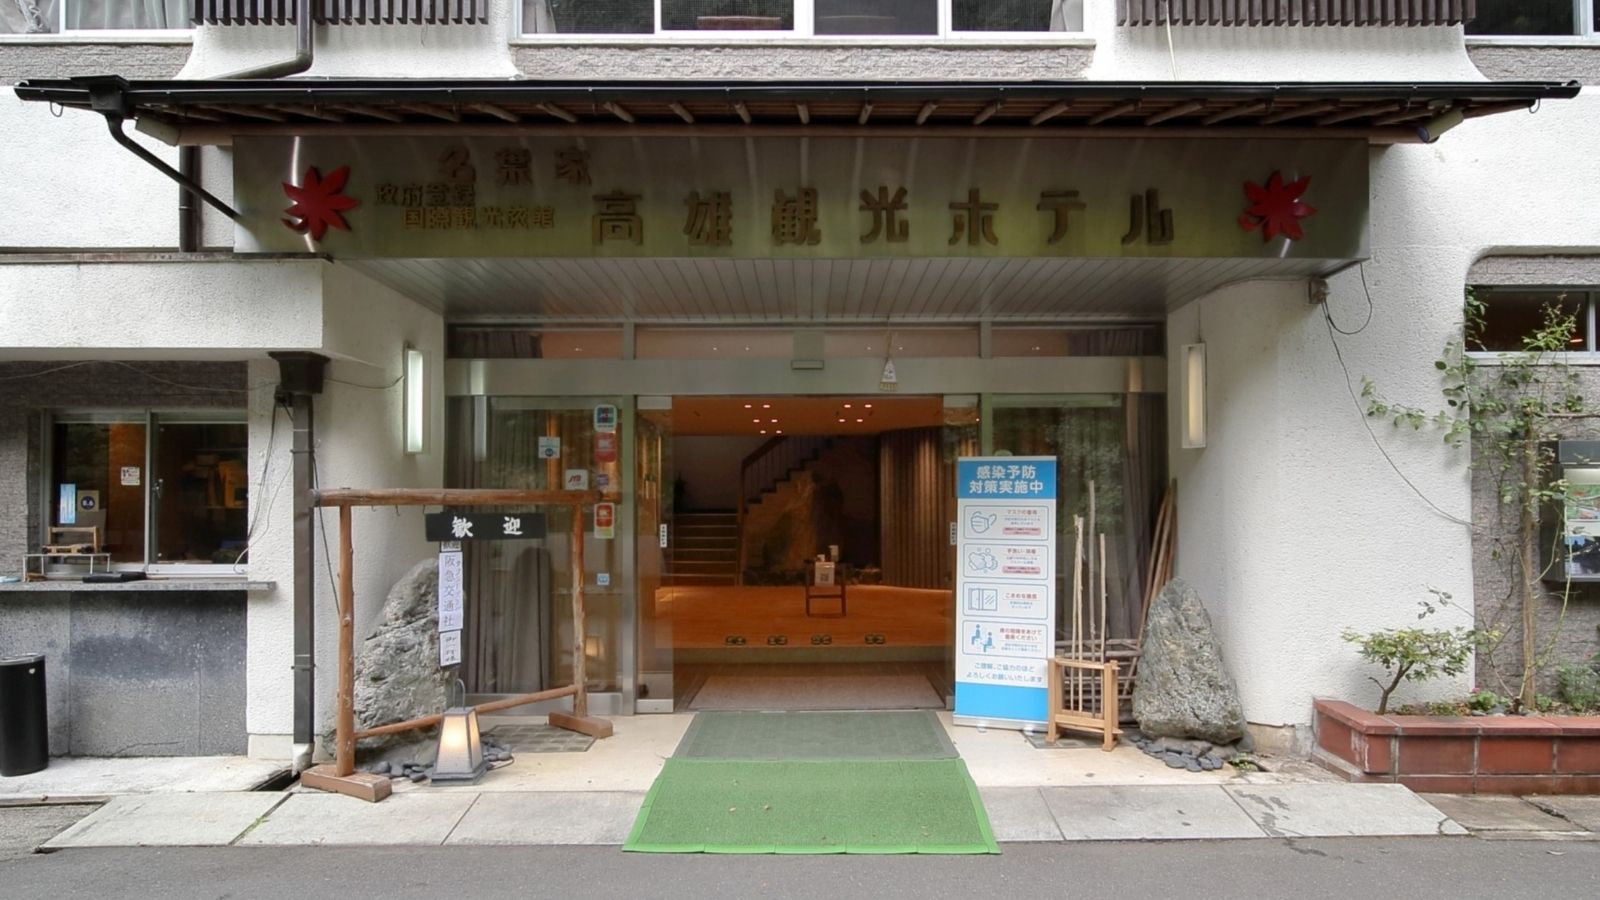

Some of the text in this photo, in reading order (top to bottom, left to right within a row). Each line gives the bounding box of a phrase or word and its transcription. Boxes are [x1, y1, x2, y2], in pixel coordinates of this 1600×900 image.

[592, 186, 1174, 246] 高雄観光ホテル
[976, 465, 1036, 480] 感染予防
[969, 480, 1044, 494] 対策実施中
[452, 516, 523, 538] 歓迎
[443, 555, 456, 627] 阪急交通社
